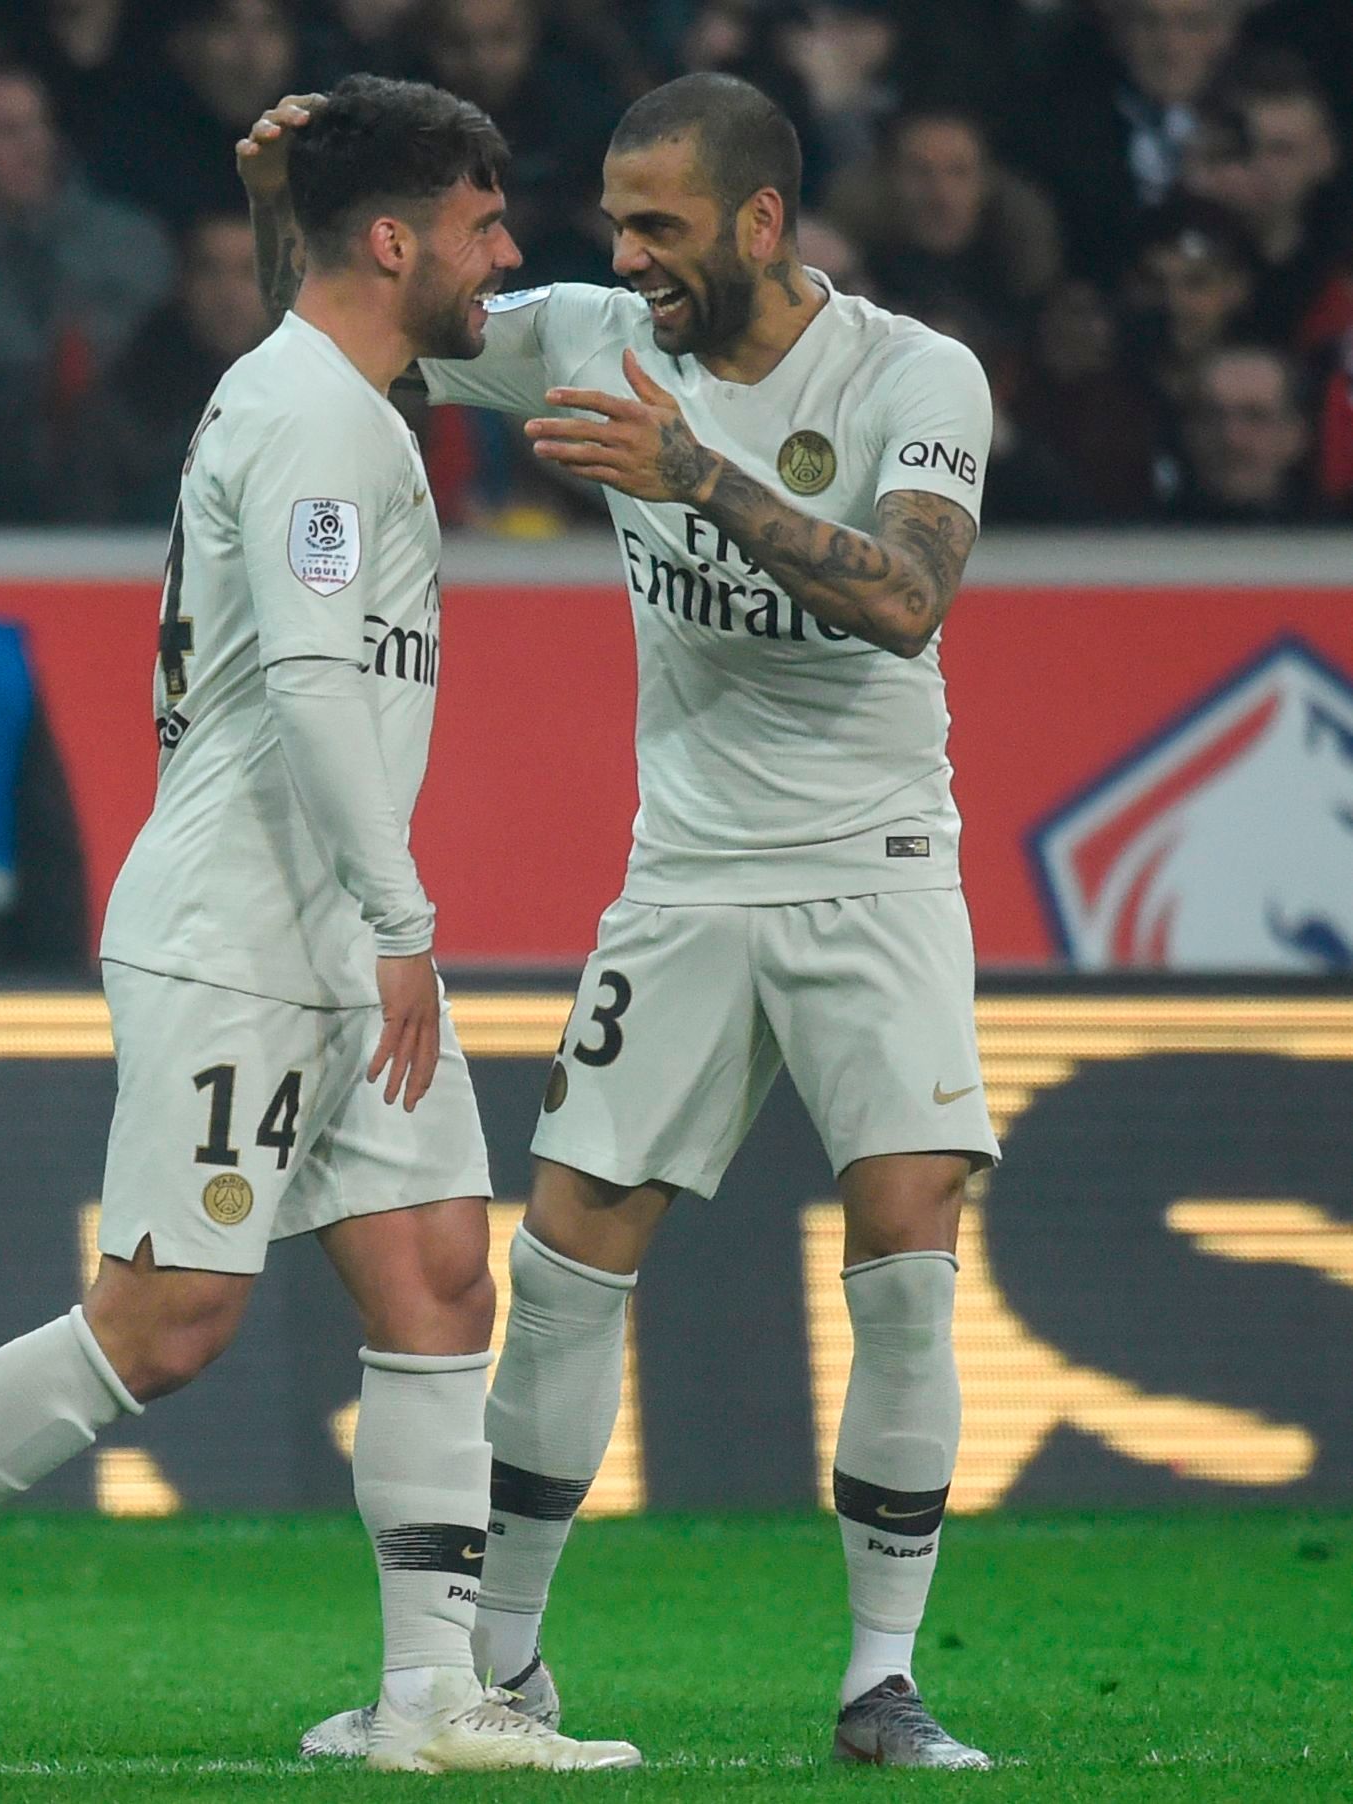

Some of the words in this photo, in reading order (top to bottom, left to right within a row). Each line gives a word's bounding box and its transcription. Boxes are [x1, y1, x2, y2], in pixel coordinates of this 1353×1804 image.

[898, 441, 977, 486] QNB
[312, 501, 340, 512] PARIS
[302, 567, 337, 576] LIGUE
[623, 528, 851, 642] Emirat
[557, 969, 632, 1067] 3
[192, 1063, 303, 1170] 14
[867, 1538, 935, 1558] PARIS
